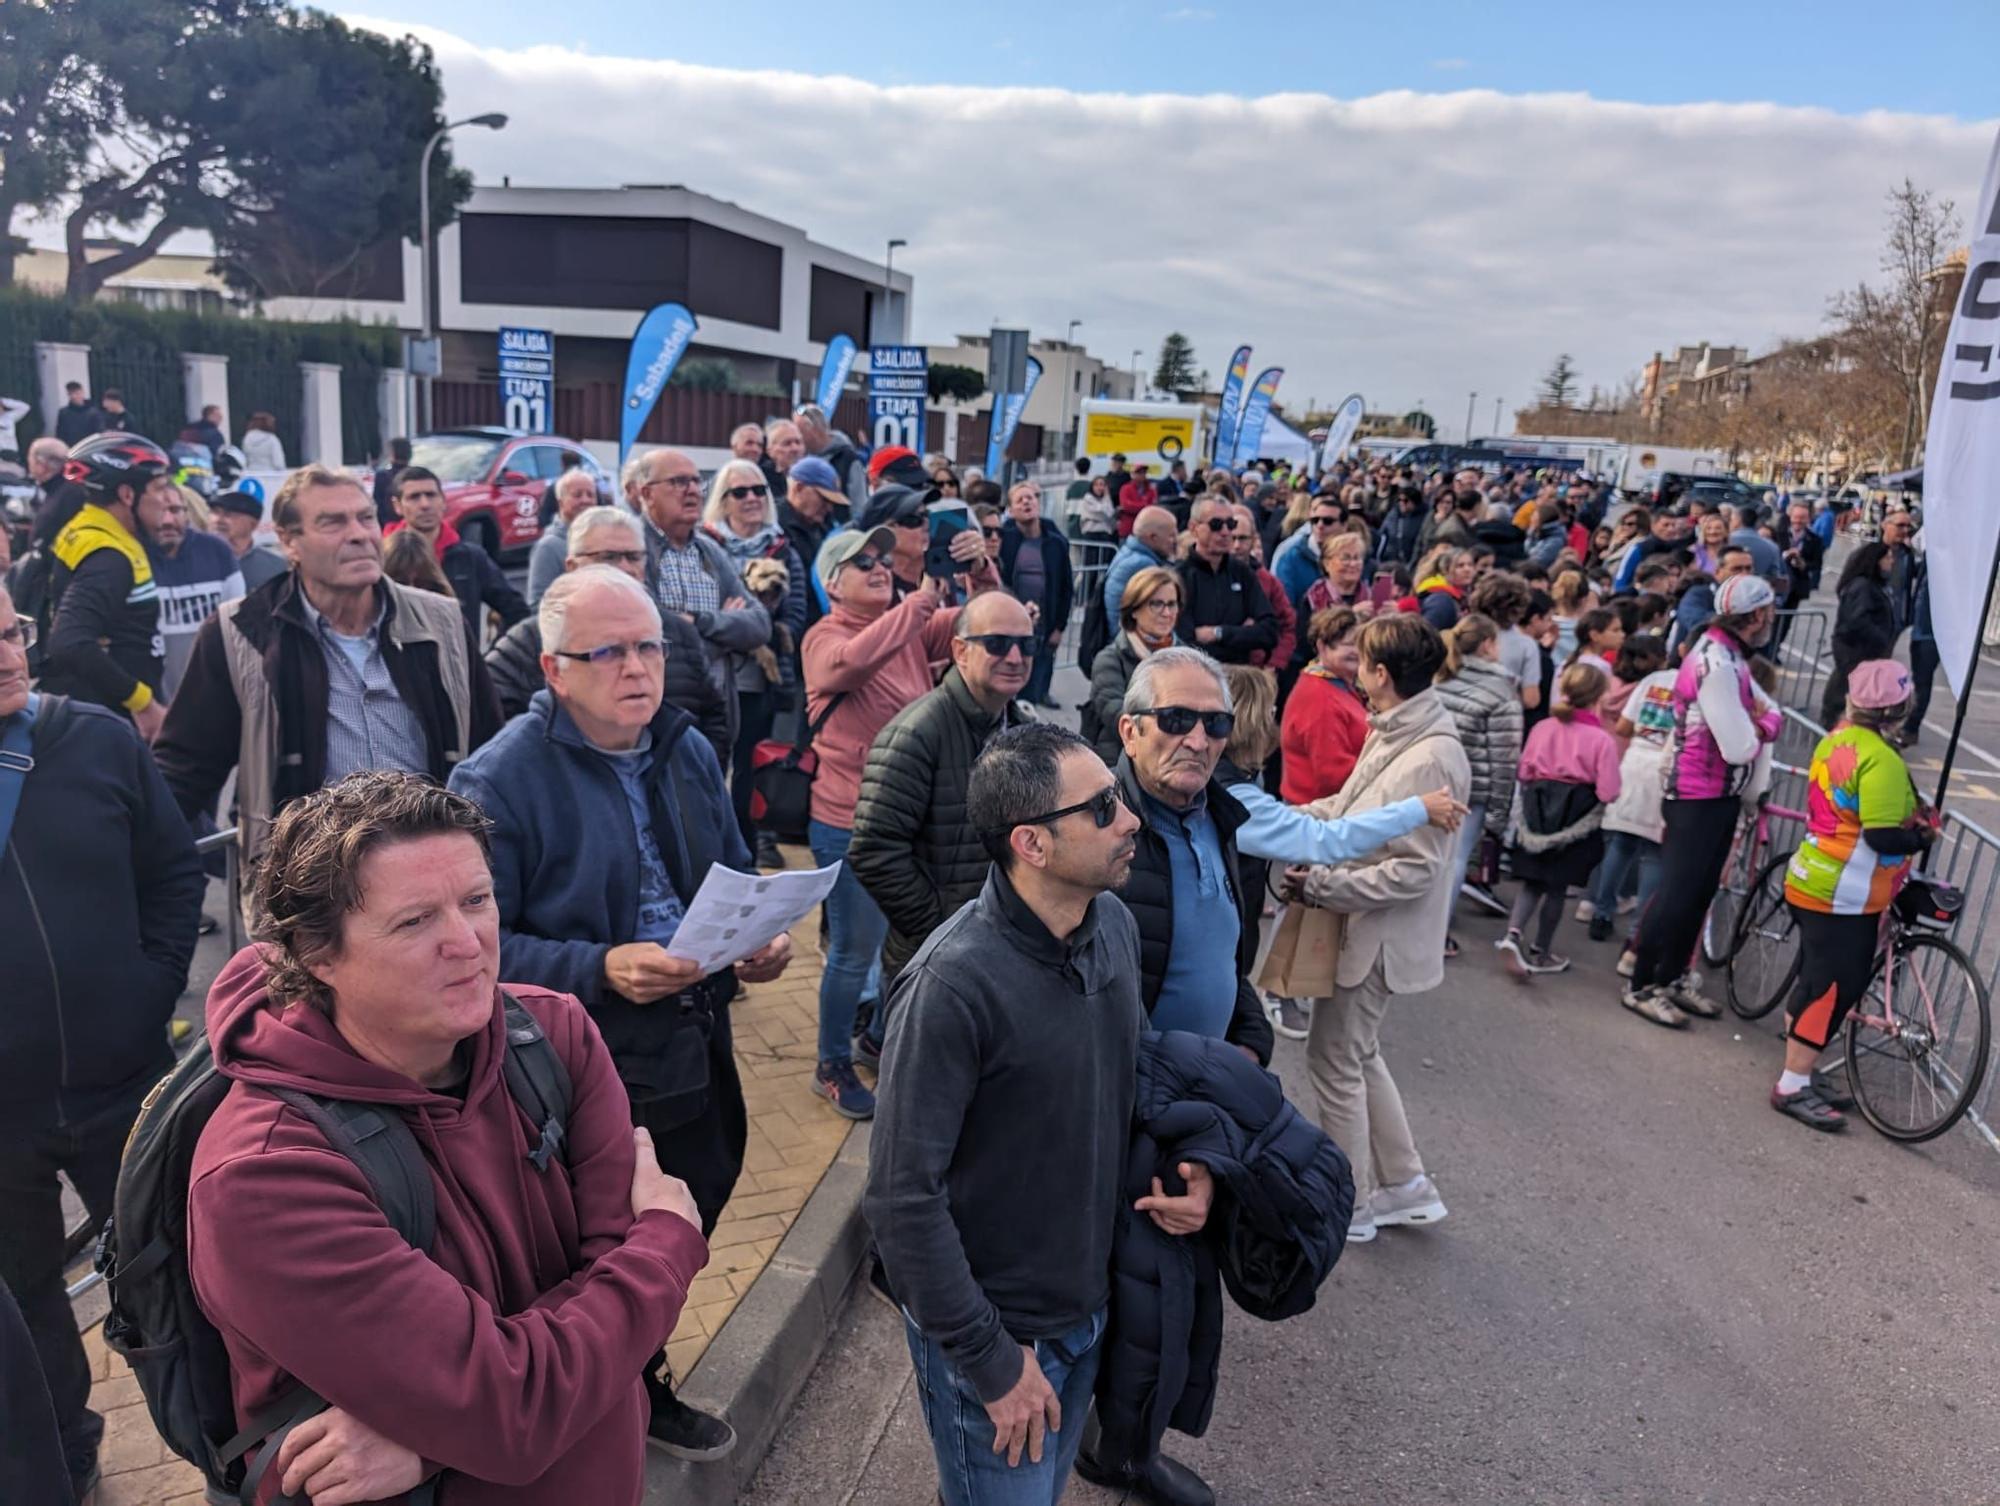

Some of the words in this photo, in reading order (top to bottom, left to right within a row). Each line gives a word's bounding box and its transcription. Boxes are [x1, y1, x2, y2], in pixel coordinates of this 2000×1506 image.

[503, 331, 547, 352] SALIDA
[635, 318, 694, 401] Sabadell
[874, 350, 923, 369] SALIDA
[505, 378, 546, 398] ETAPA
[505, 395, 546, 433] 01
[876, 398, 919, 416] ETAPA
[874, 415, 919, 453] 01
